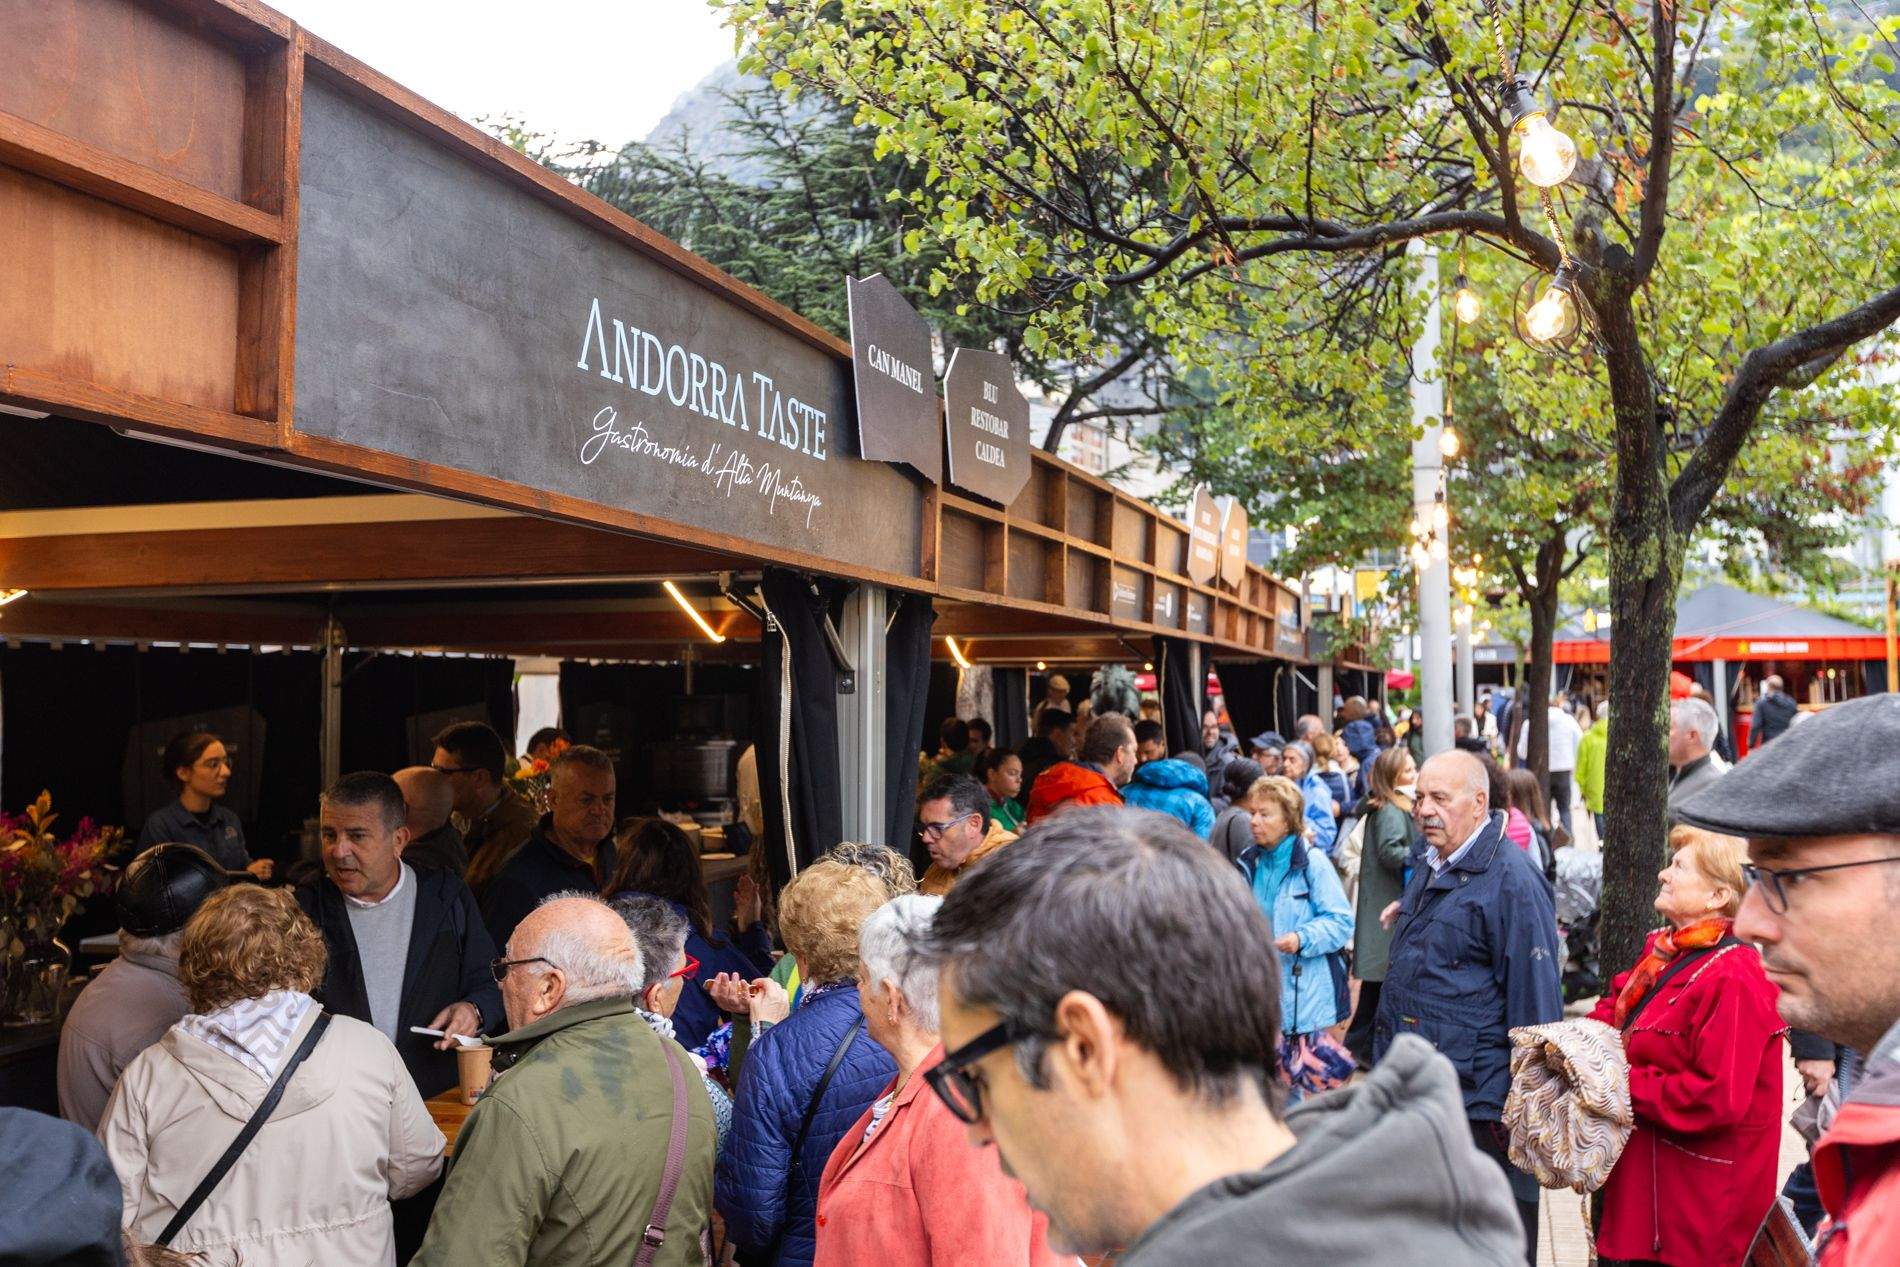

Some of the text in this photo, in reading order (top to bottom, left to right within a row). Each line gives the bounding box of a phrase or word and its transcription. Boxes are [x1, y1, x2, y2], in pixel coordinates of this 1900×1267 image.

[577, 298, 826, 461] ANDORRA TASTE
[868, 344, 923, 394] CAN MANEL
[982, 380, 999, 404] BLU
[971, 406, 1009, 439] RESTOBAR
[581, 406, 699, 468] Gastronomia
[756, 462, 822, 528] Muntanya
[976, 440, 1005, 468] CALDEA
